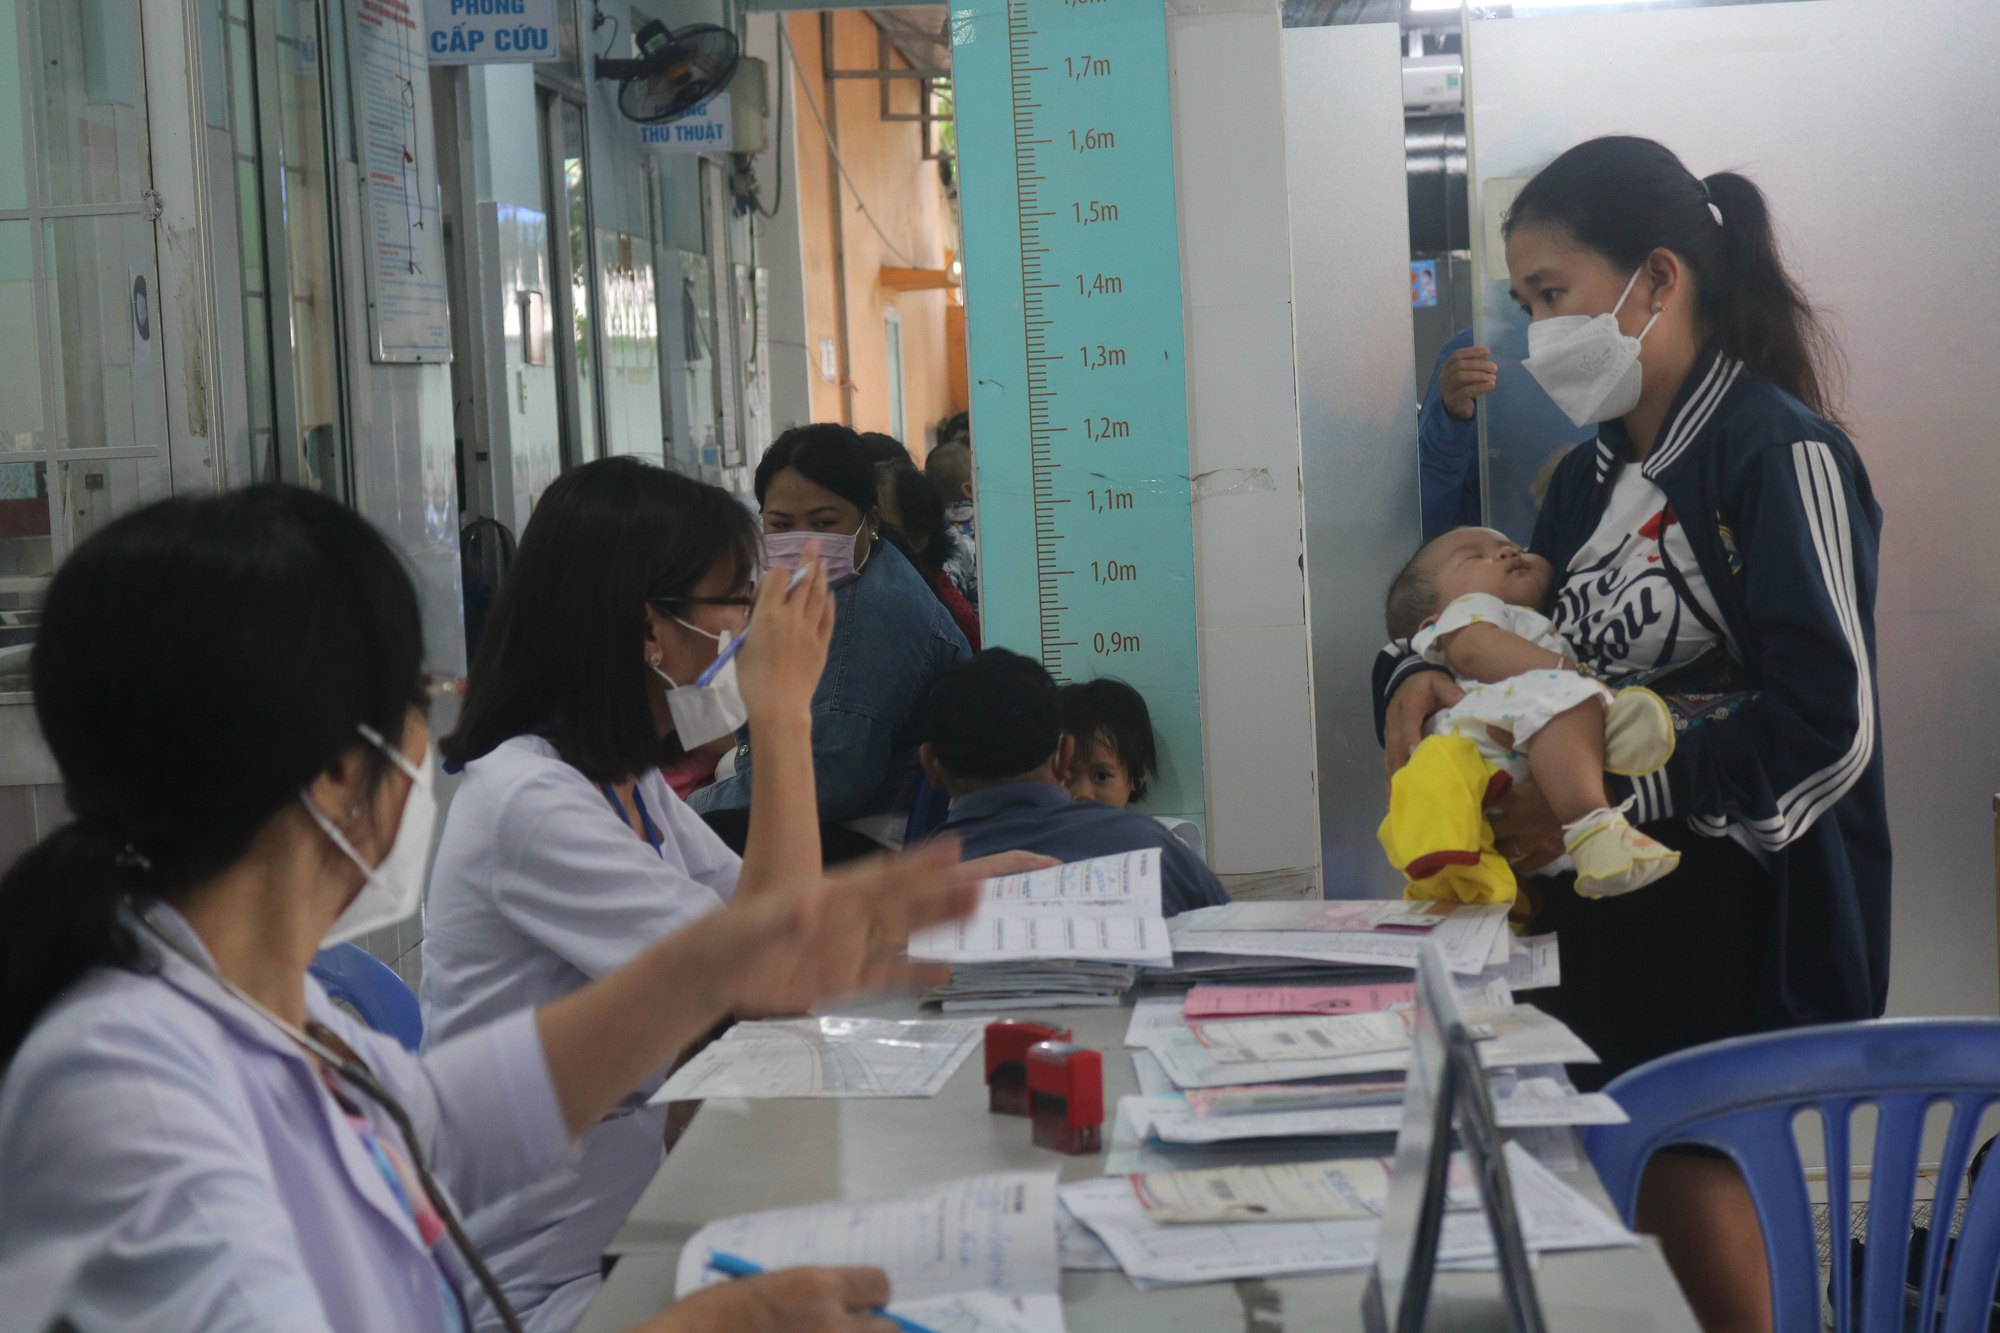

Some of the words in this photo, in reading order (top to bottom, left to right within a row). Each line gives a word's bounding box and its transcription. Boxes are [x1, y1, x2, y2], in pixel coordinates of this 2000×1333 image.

[430, 21, 485, 53] CẤP
[494, 23, 548, 51] CỨU
[1065, 56, 1111, 81] 1,7m
[674, 120, 724, 144] THUẬT
[1068, 128, 1115, 154] 1,6m
[1072, 201, 1119, 226] 1,5m
[1076, 273, 1122, 299] 1,4m
[1080, 345, 1126, 371] 1,3m
[1083, 417, 1130, 442] 1,2m
[1087, 489, 1134, 514] 1,1m
[1091, 560, 1137, 586] 1,0m
[1094, 632, 1140, 657] 0,9m
